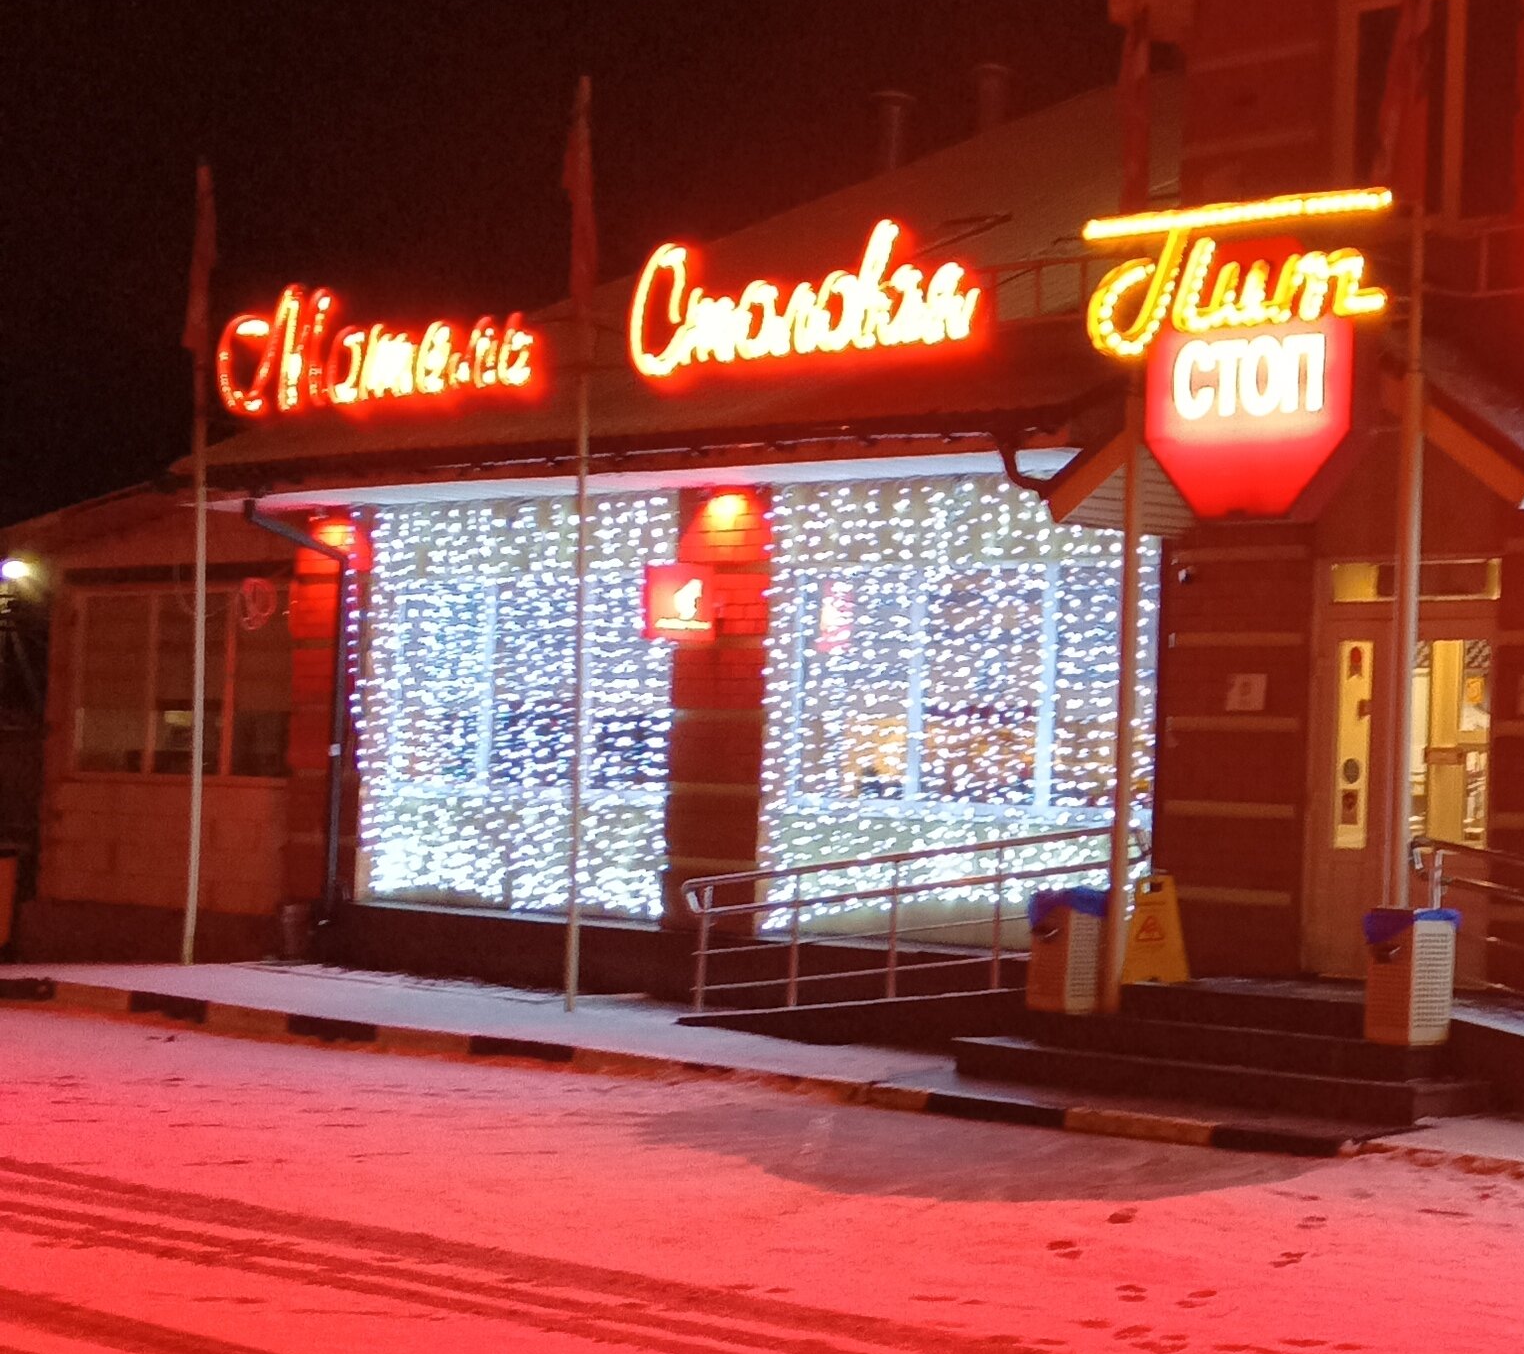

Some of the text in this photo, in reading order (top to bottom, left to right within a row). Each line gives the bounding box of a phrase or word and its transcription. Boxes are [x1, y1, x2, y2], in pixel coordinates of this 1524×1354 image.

[629, 218, 981, 377] Столовая
[1081, 186, 1393, 359] Пит
[217, 283, 534, 412] Мотель
[1172, 332, 1327, 421] СТОП
